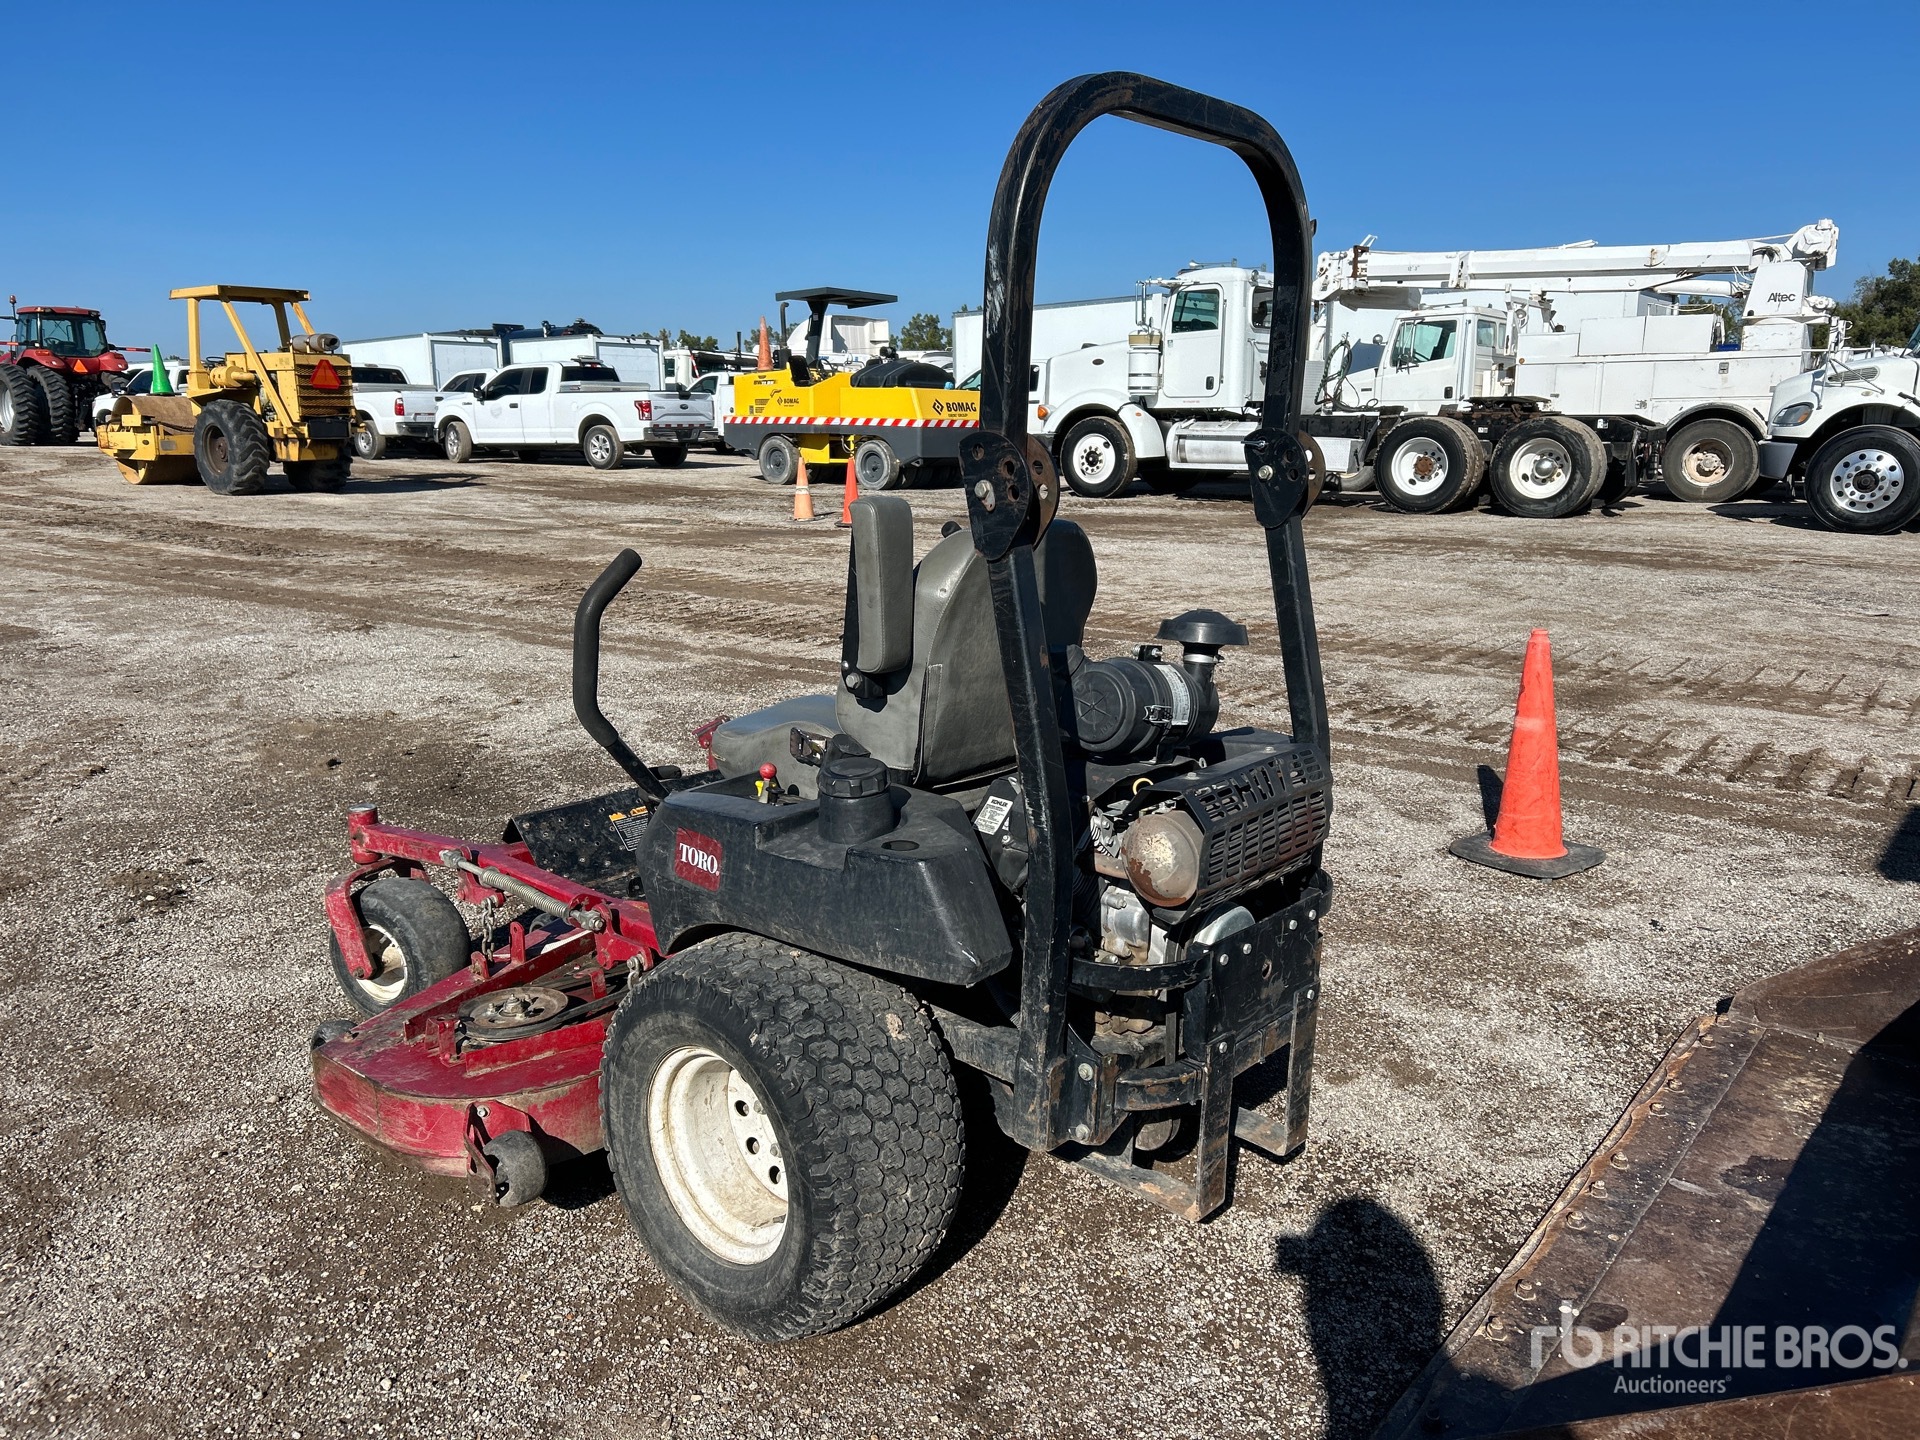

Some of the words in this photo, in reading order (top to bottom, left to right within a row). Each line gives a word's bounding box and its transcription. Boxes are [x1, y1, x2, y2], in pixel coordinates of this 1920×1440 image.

[1767, 292, 1796, 303] Altec
[945, 402, 977, 412] BOMAG
[990, 799, 1009, 807] KOHLER
[679, 842, 718, 874] TORO
